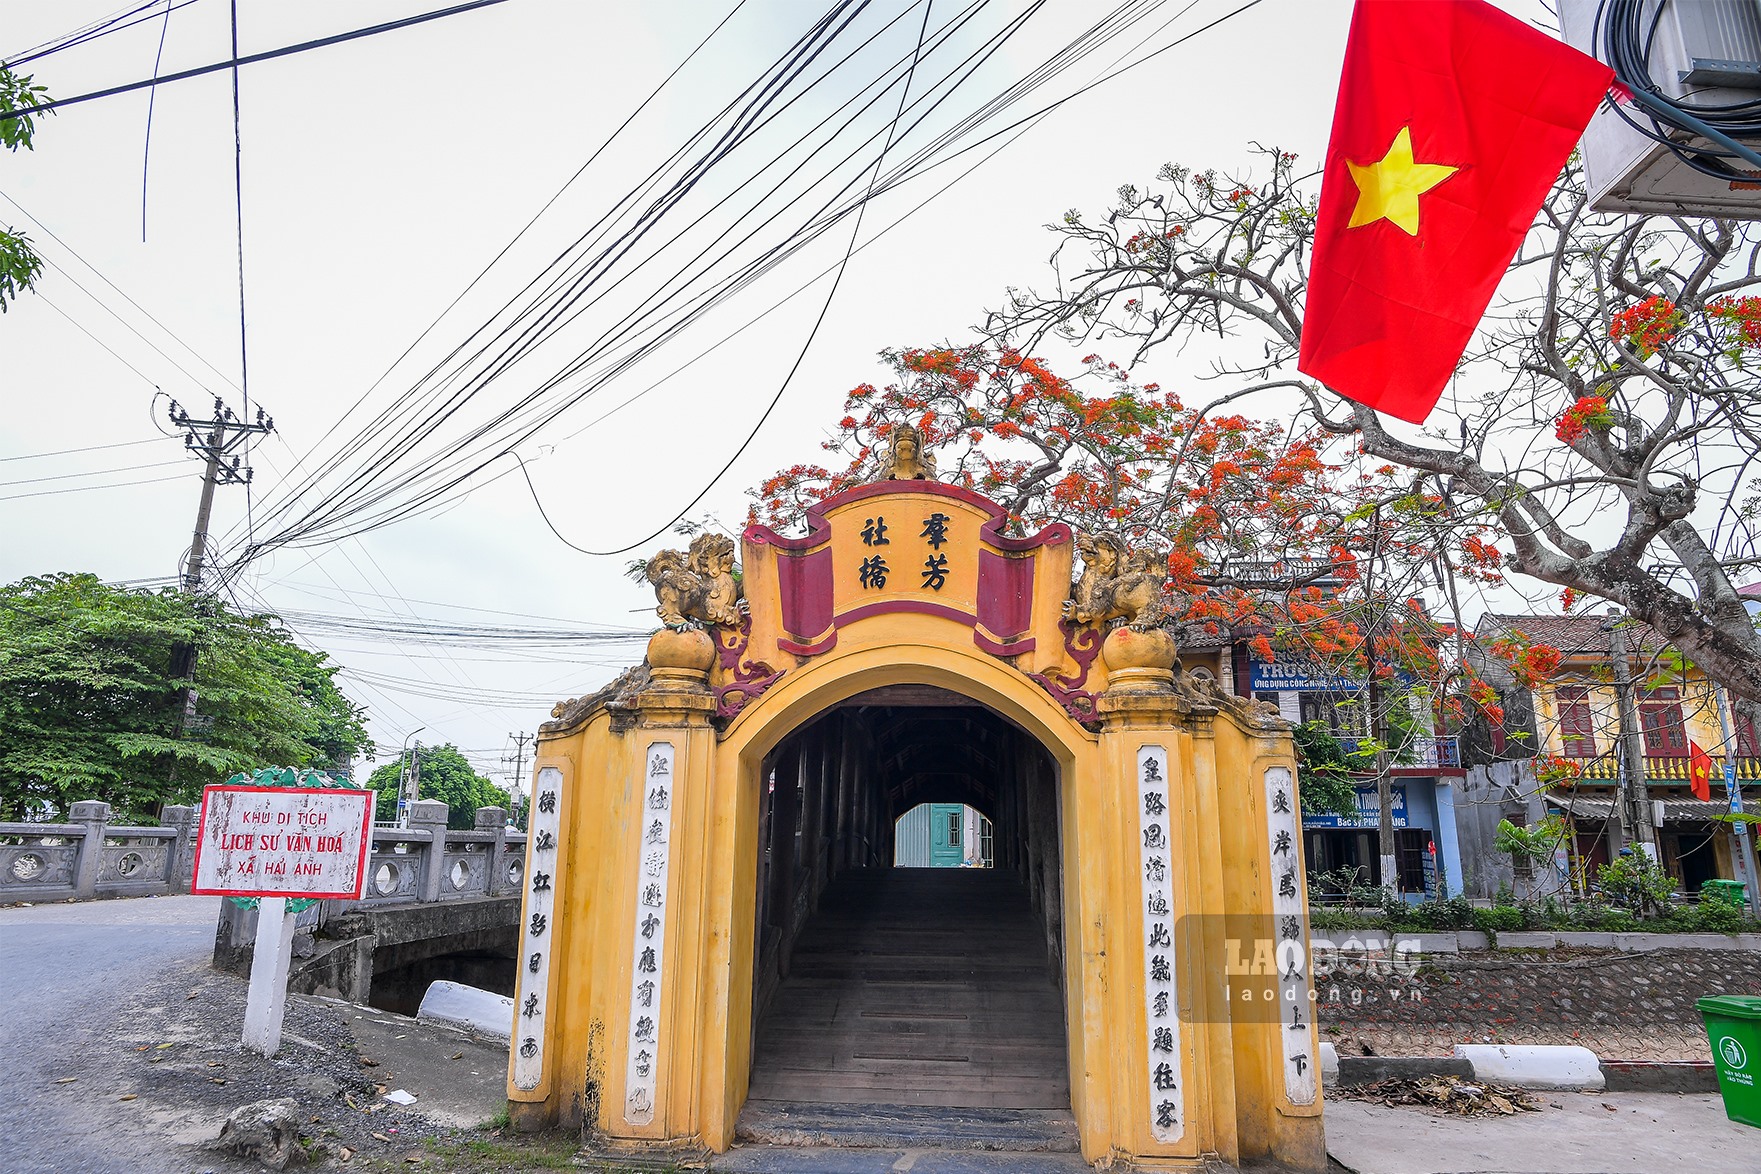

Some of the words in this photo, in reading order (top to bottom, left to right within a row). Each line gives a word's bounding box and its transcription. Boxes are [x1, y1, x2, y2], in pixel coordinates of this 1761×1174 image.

[243, 811, 270, 824] KHU
[277, 812, 291, 825] DI
[298, 808, 327, 825] TÍCH
[221, 833, 254, 853] LỊCH
[287, 833, 311, 852] VĂN
[317, 831, 346, 853] HOÁ
[264, 858, 286, 875] HẢI
[294, 863, 323, 875] ANH
